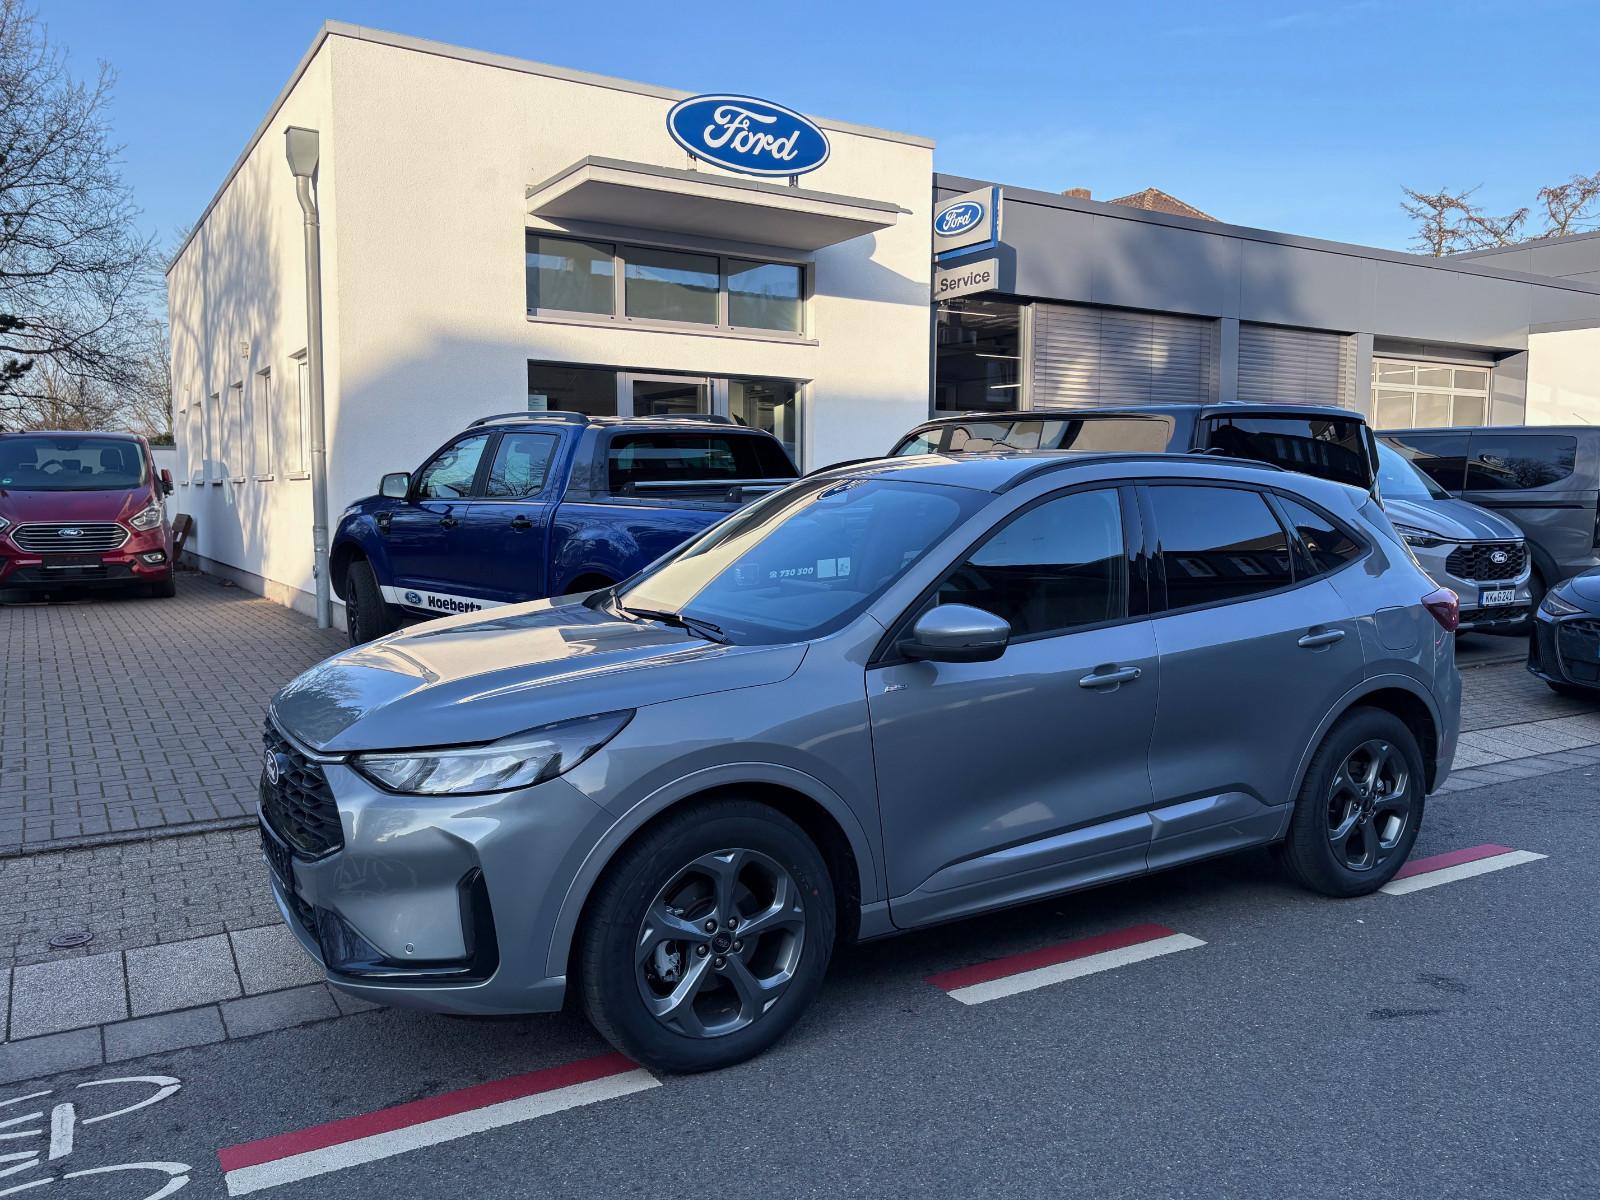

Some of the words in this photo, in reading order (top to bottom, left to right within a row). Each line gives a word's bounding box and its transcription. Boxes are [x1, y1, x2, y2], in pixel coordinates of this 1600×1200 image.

[703, 105, 801, 161] Ford
[942, 207, 972, 231] Ford
[940, 271, 991, 292] Service
